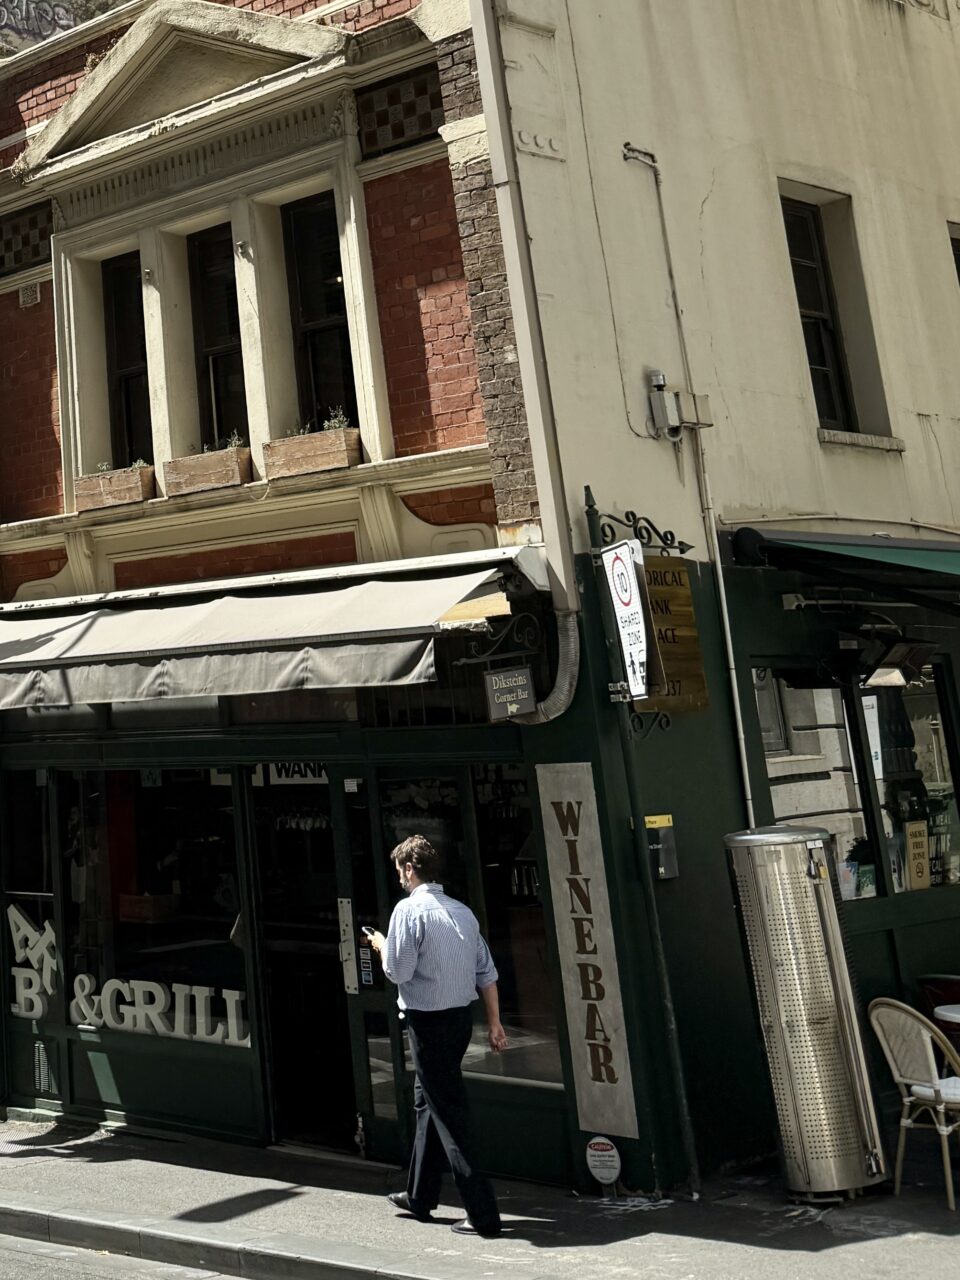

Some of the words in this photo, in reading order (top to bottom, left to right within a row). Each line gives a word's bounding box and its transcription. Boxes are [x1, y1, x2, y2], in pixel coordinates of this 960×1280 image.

[617, 571, 628, 595] 10
[620, 611, 641, 629] SHARED
[627, 630, 642, 646] ZONE
[495, 693, 517, 704] Corner
[517, 689, 529, 700] Bar
[912, 841, 924, 850] FREE
[100, 978, 252, 1049] GRILL
